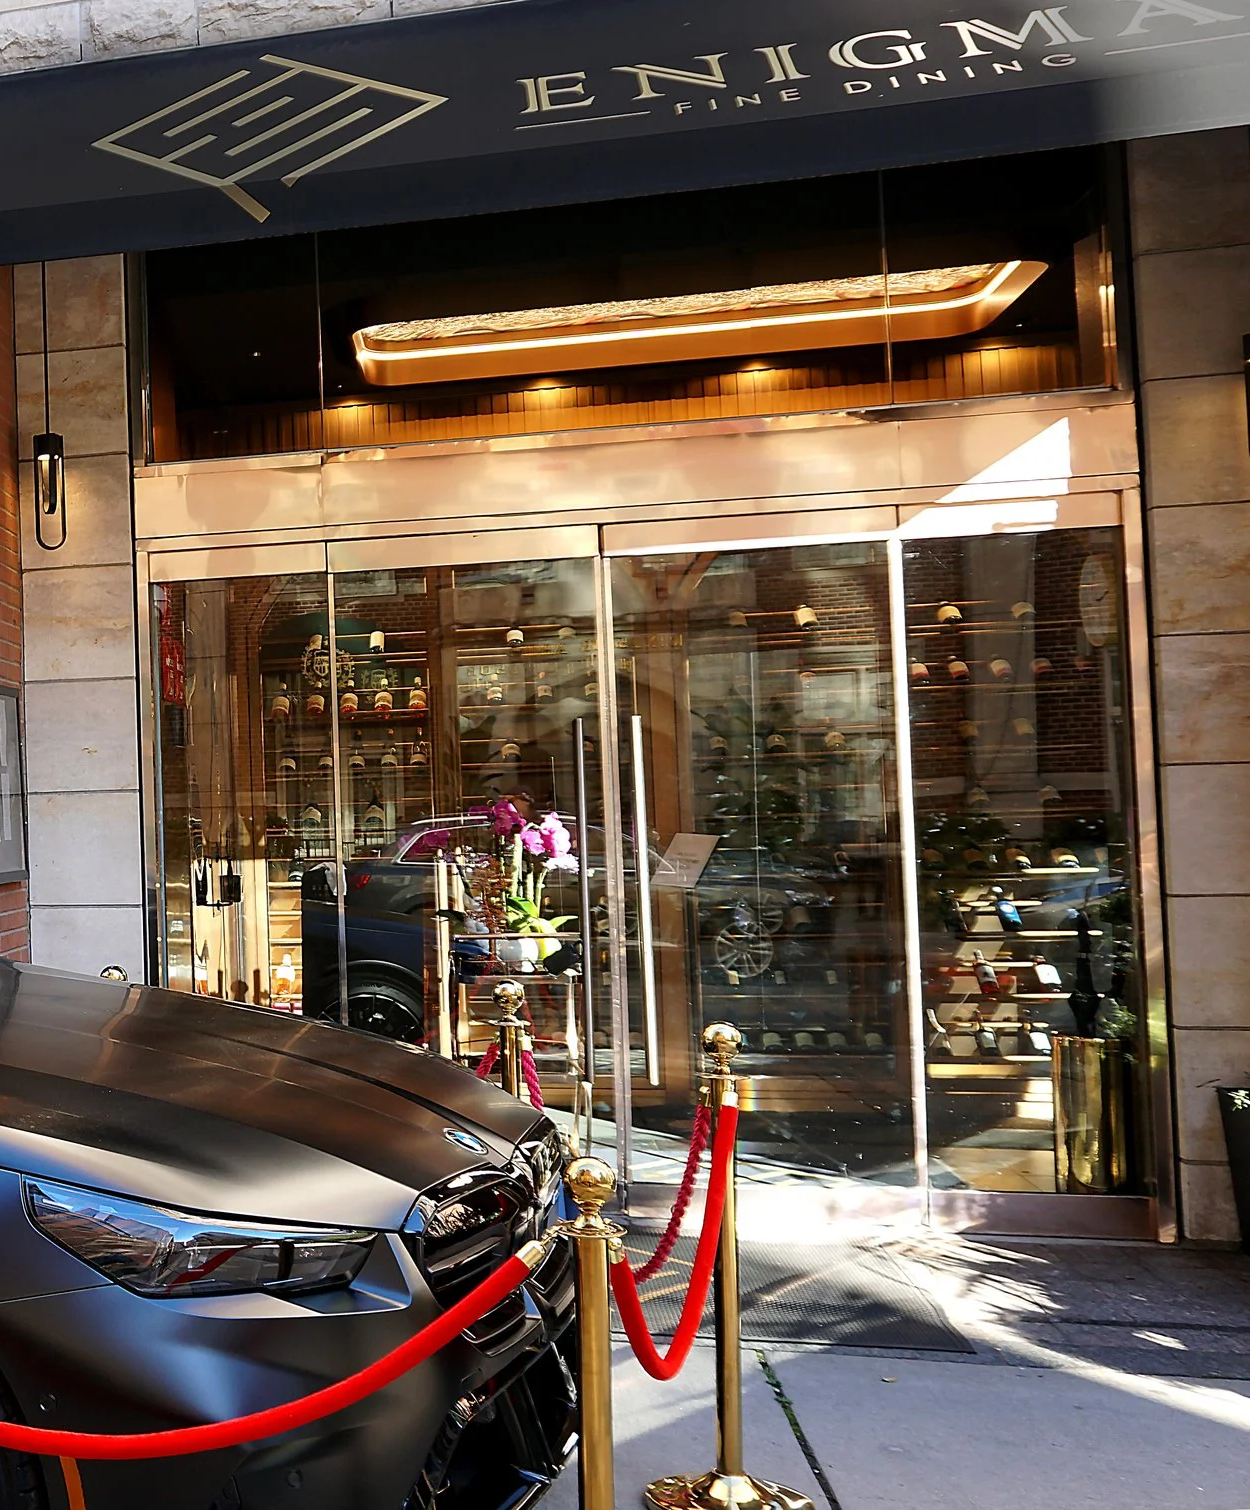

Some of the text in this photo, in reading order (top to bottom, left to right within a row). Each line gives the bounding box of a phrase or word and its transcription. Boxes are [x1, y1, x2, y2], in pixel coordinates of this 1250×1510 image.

[515, 0, 1246, 114] ENIGMA
[673, 53, 1077, 116] FINE DINING
